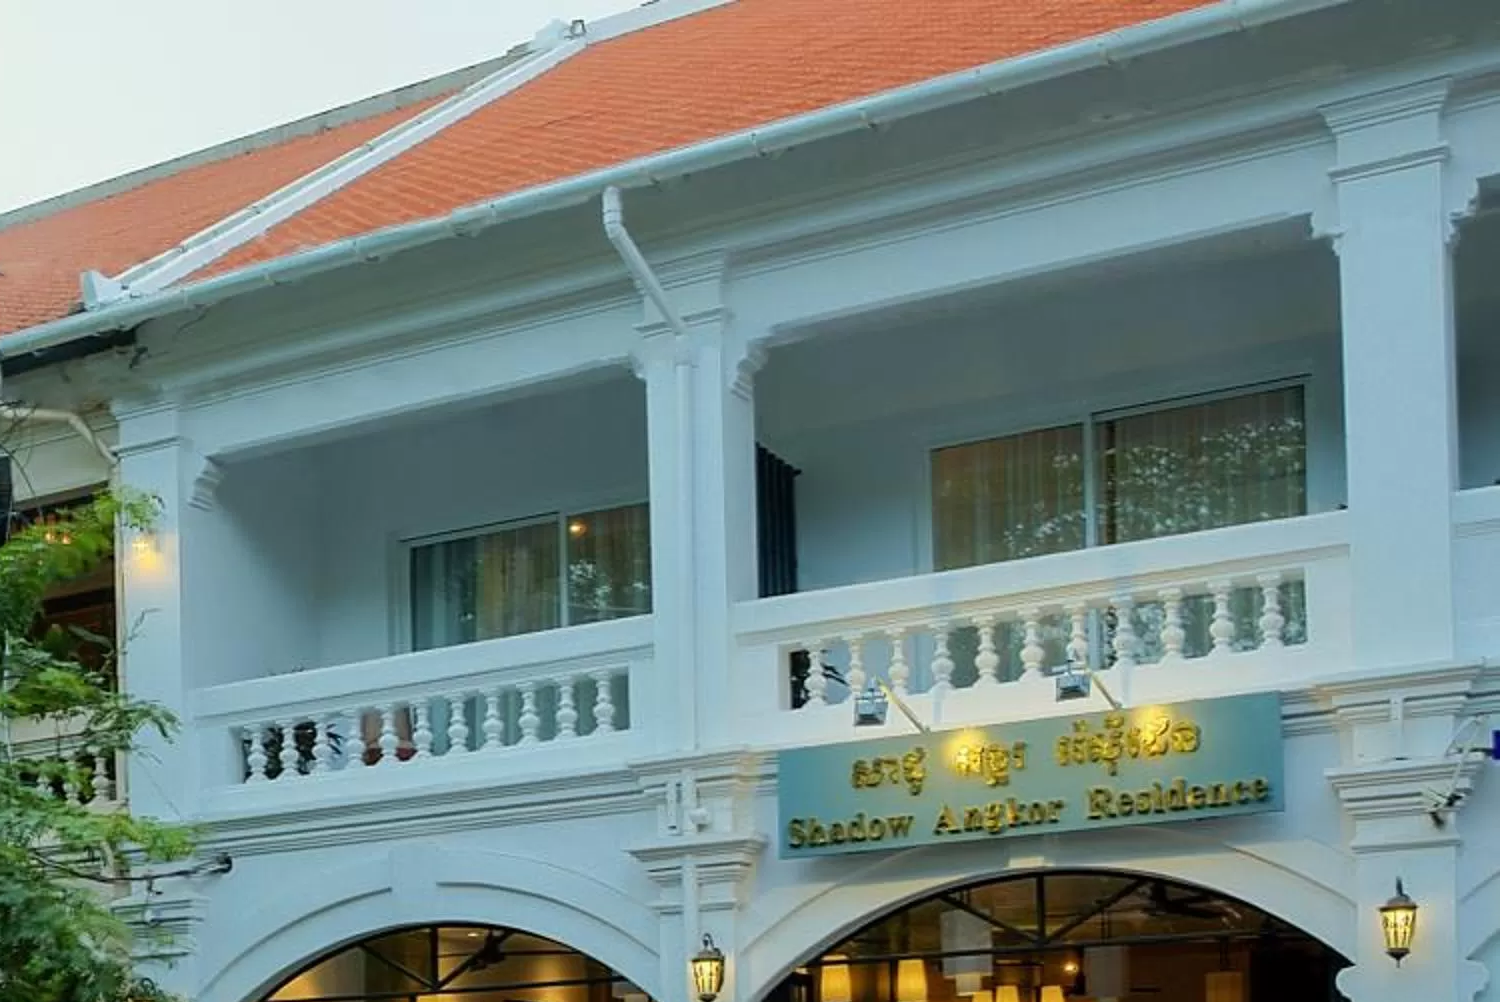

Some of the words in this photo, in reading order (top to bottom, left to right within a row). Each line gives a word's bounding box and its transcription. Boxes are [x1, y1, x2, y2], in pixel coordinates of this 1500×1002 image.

[787, 812, 915, 848] Shadow
[932, 797, 1065, 835] Angkor
[1087, 776, 1271, 820] Residence
